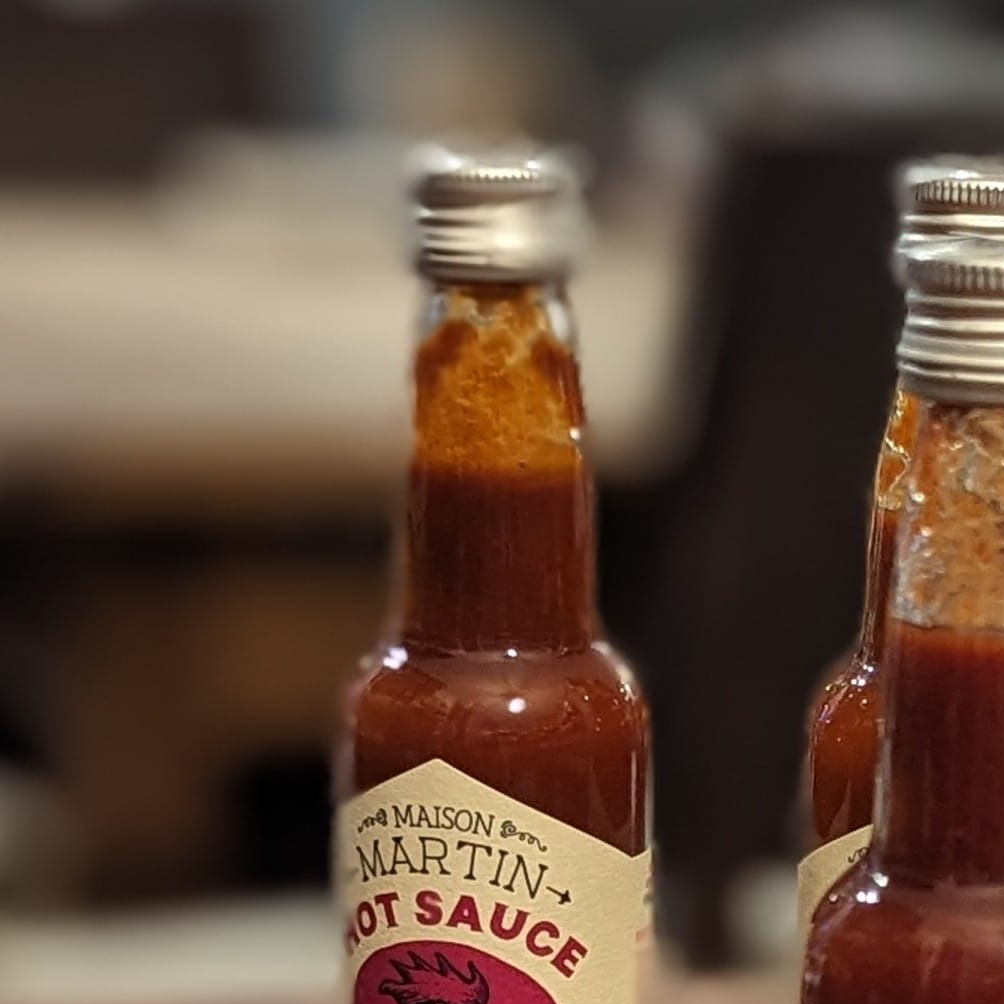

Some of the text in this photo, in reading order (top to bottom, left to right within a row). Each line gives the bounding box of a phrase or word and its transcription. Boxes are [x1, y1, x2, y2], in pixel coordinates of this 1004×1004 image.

[392, 804, 496, 836] MAISON
[356, 836, 549, 900] MARTIN
[414, 890, 589, 979] SAUCE
